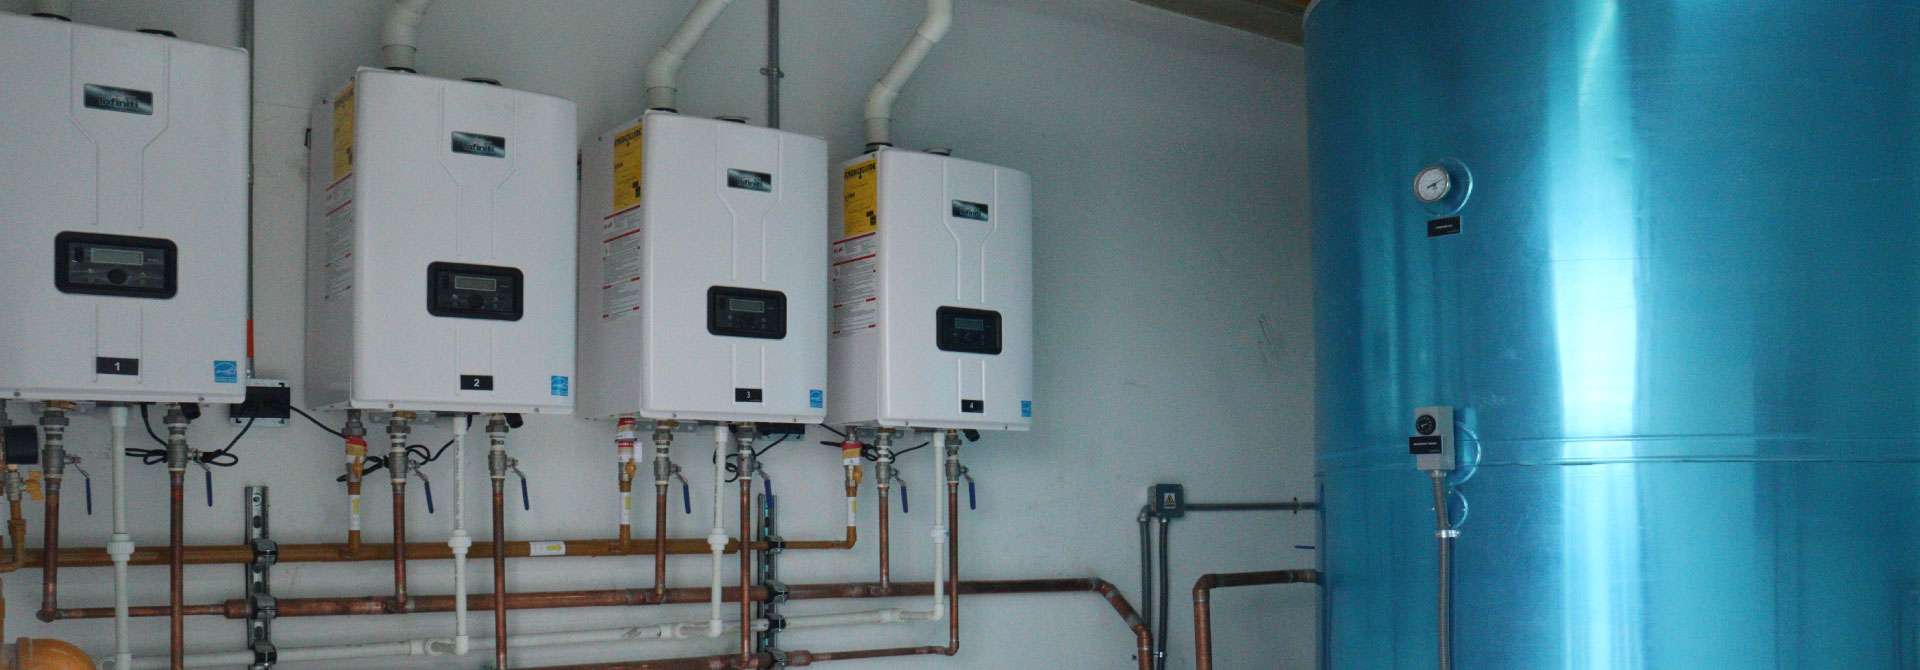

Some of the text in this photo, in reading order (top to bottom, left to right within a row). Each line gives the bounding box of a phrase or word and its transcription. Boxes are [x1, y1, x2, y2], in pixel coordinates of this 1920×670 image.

[114, 361, 120, 371] 1
[473, 378, 480, 387] 2
[746, 391, 751, 399] 3
